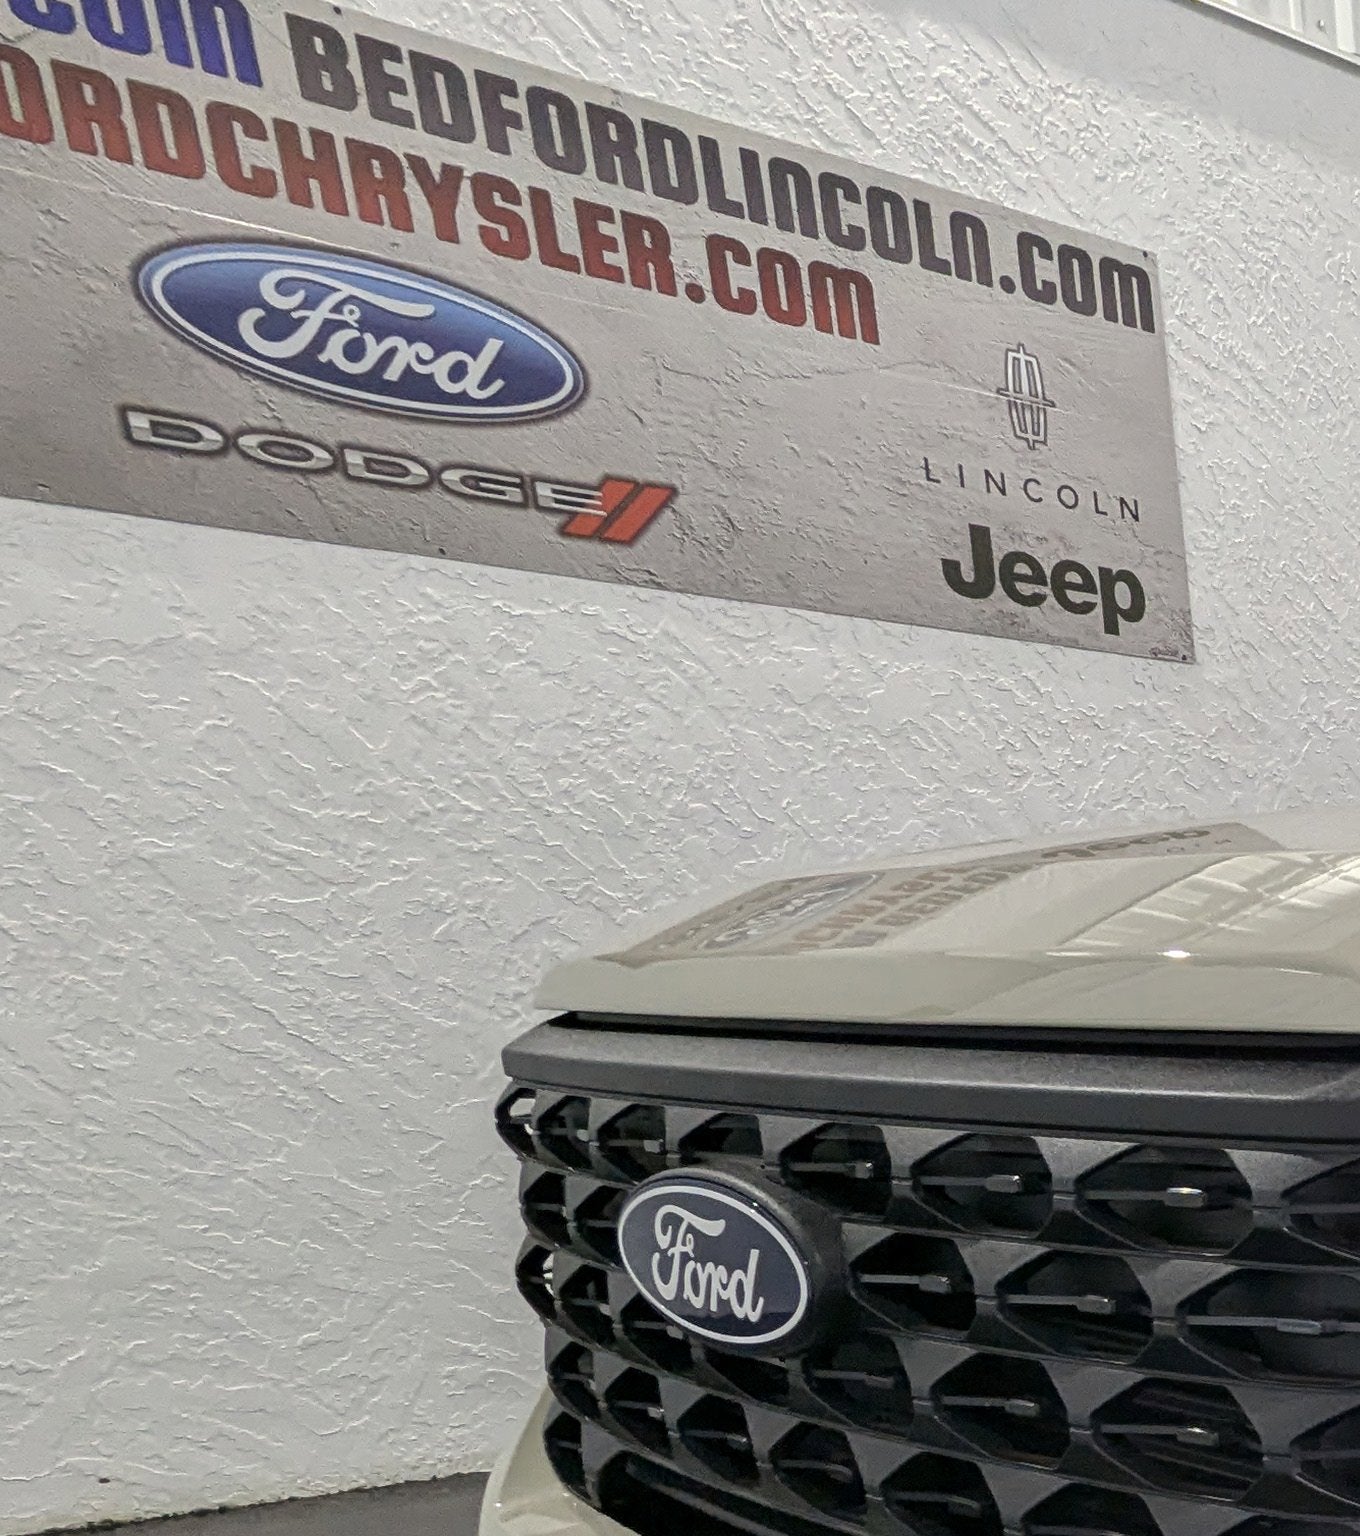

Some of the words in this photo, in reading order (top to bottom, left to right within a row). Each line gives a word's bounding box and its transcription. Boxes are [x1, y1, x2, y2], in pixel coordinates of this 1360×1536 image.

[285, 11, 1156, 334] BEDFORDLINCOLN.COM
[238, 268, 505, 400] Ford
[123, 408, 609, 520] DODGE
[923, 456, 1141, 523] LINCOLN
[941, 523, 1147, 636] Jeep
[652, 1205, 764, 1323] Ford
